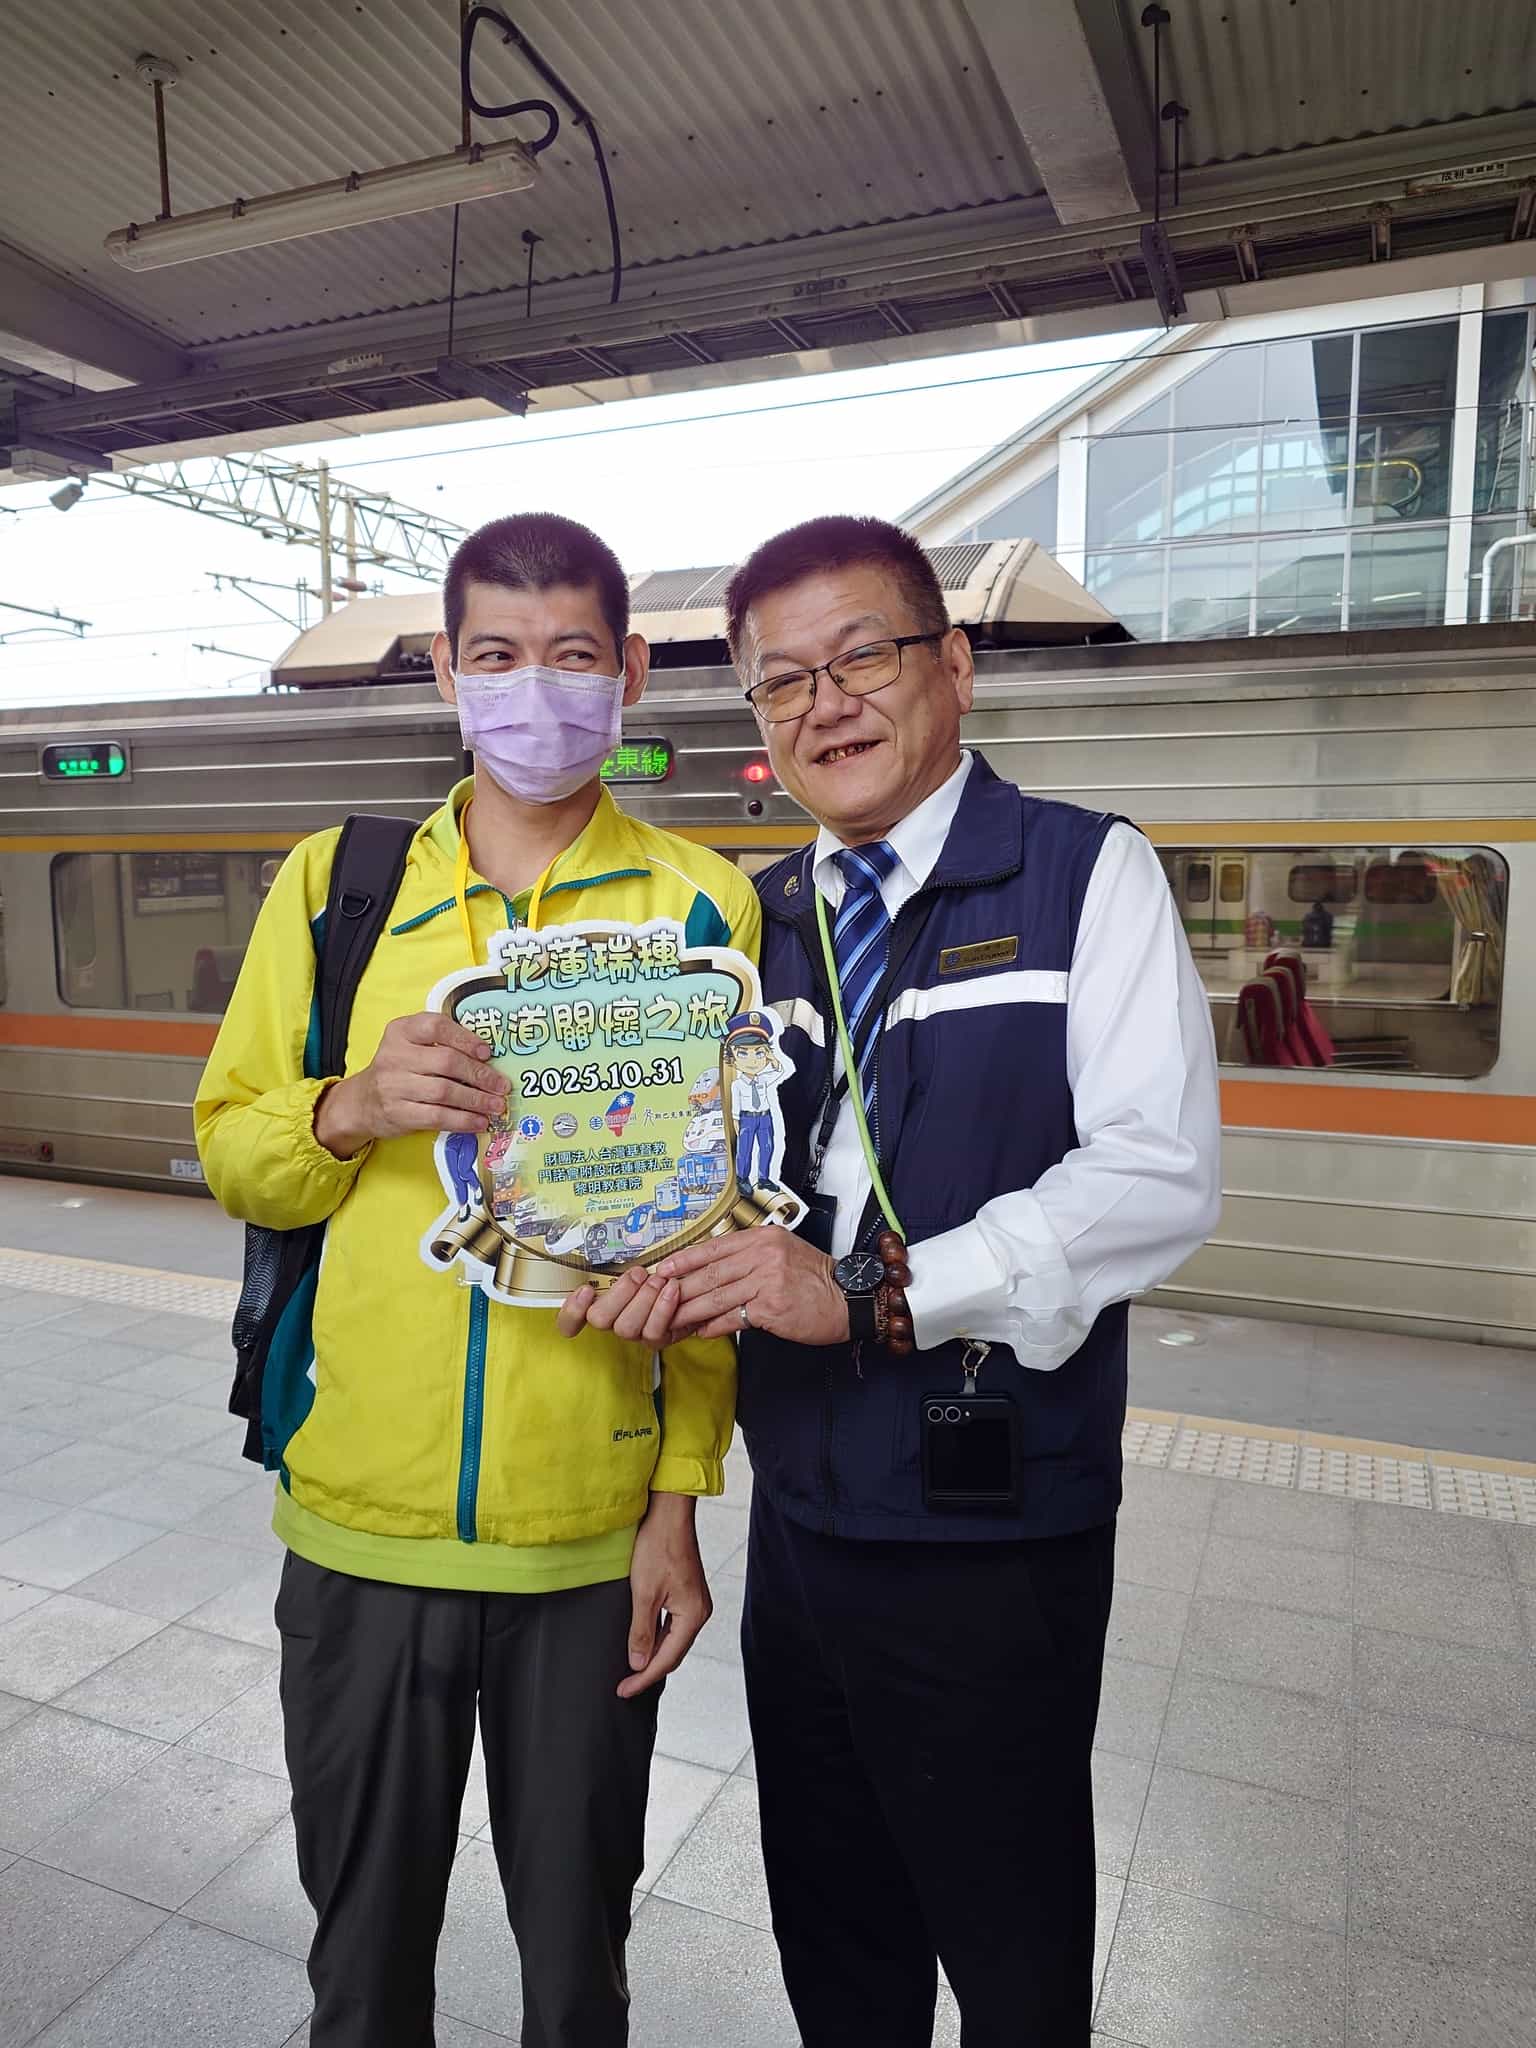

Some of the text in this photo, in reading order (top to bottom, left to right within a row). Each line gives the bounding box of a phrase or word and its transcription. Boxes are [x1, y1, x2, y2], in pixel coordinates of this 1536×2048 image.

[501, 929, 681, 992] 花蓮瑞穗
[460, 989, 731, 1057] 鐵道關懷之旅
[521, 1057, 684, 1098] 2025.10.31
[544, 1141, 667, 1166] 財團法人台灣基督教
[538, 1158, 674, 1184] 門諾會附設花蓮縣私立
[574, 1176, 643, 1196] 黎明教養院
